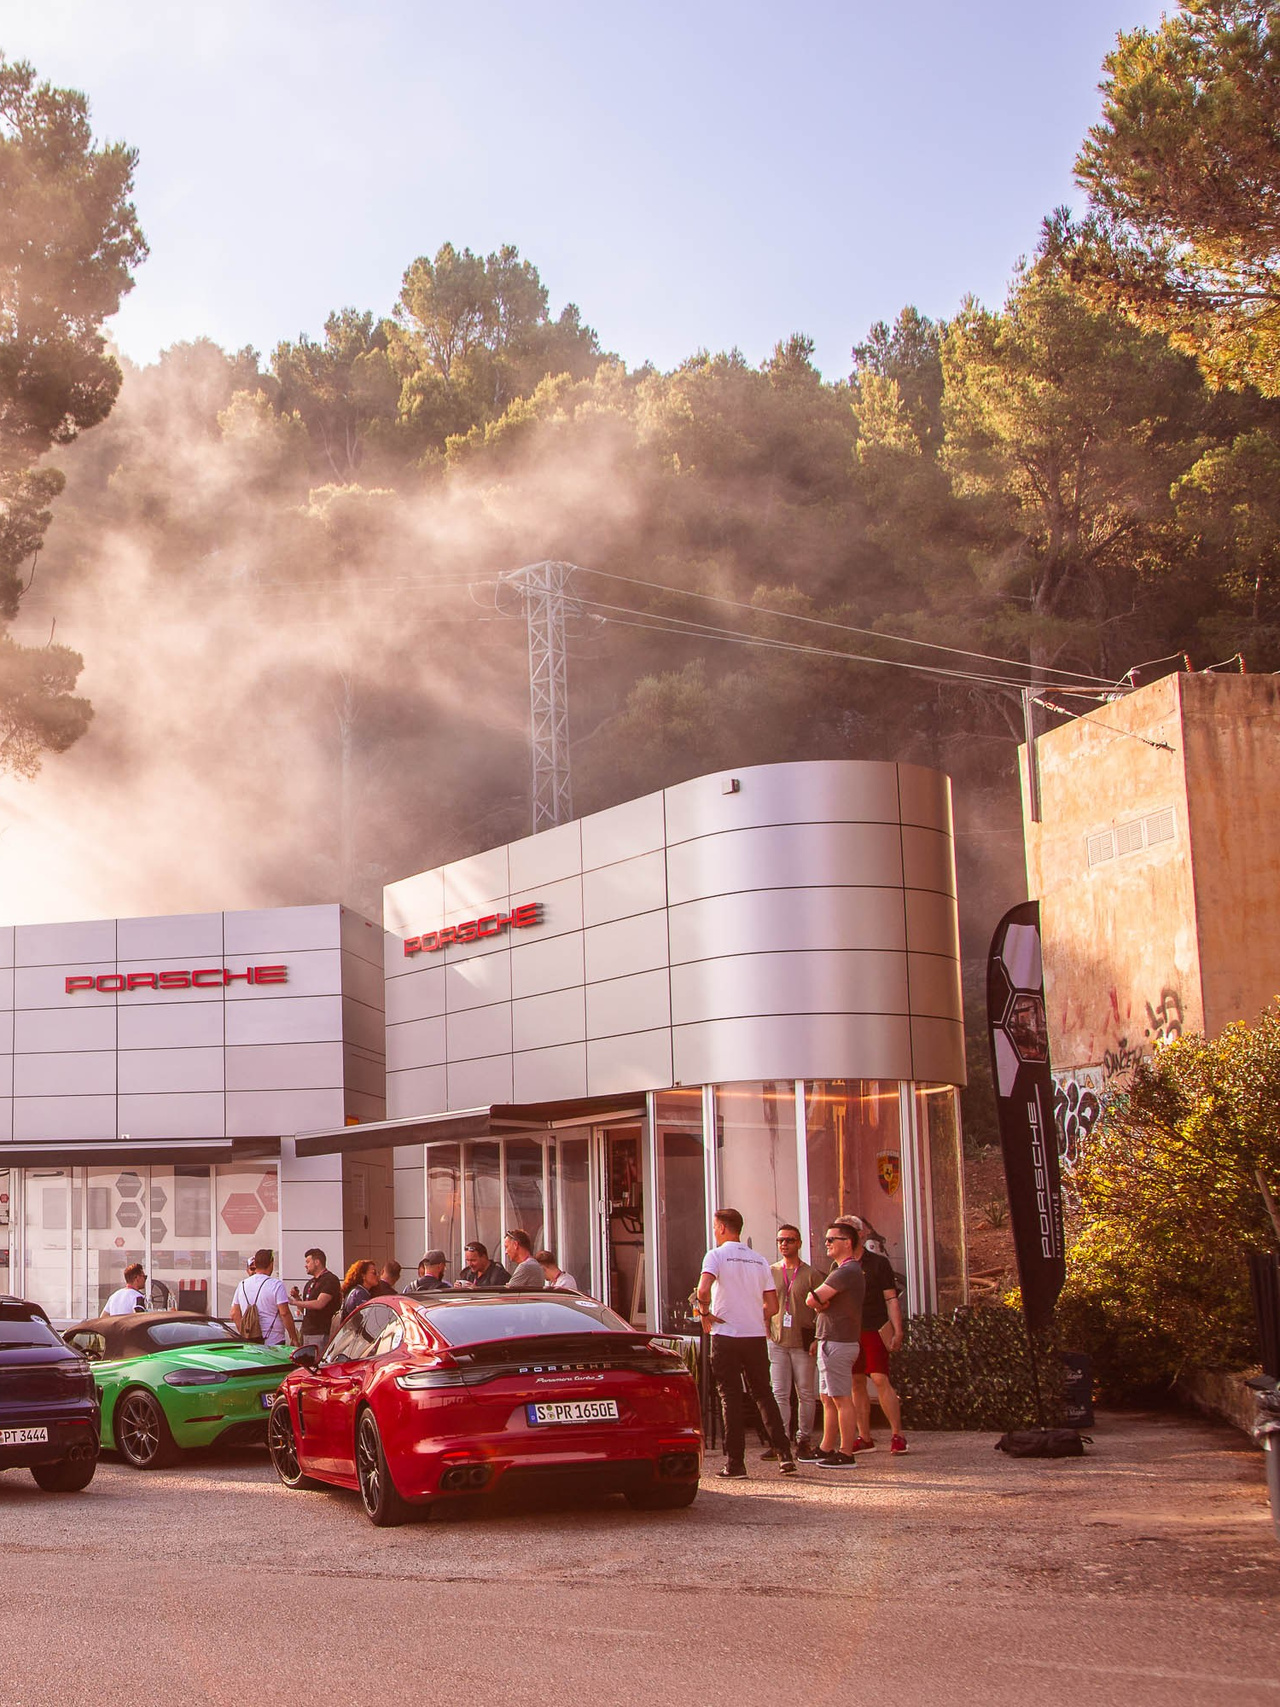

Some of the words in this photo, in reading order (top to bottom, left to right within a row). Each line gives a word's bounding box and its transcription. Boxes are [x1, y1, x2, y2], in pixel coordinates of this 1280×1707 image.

[403, 902, 543, 958] PORSCHE
[65, 965, 288, 994] PORSCHE
[1027, 1102, 1052, 1259] PORSCHE
[1052, 1192, 1062, 1259] LIFESTYLE
[519, 1363, 612, 1374] PORSCHE
[537, 1406, 547, 1420] S
[556, 1404, 573, 1420] PR
[575, 1402, 616, 1418] 1650E
[4, 1431, 17, 1442] PT
[20, 1429, 46, 1442] 3444
